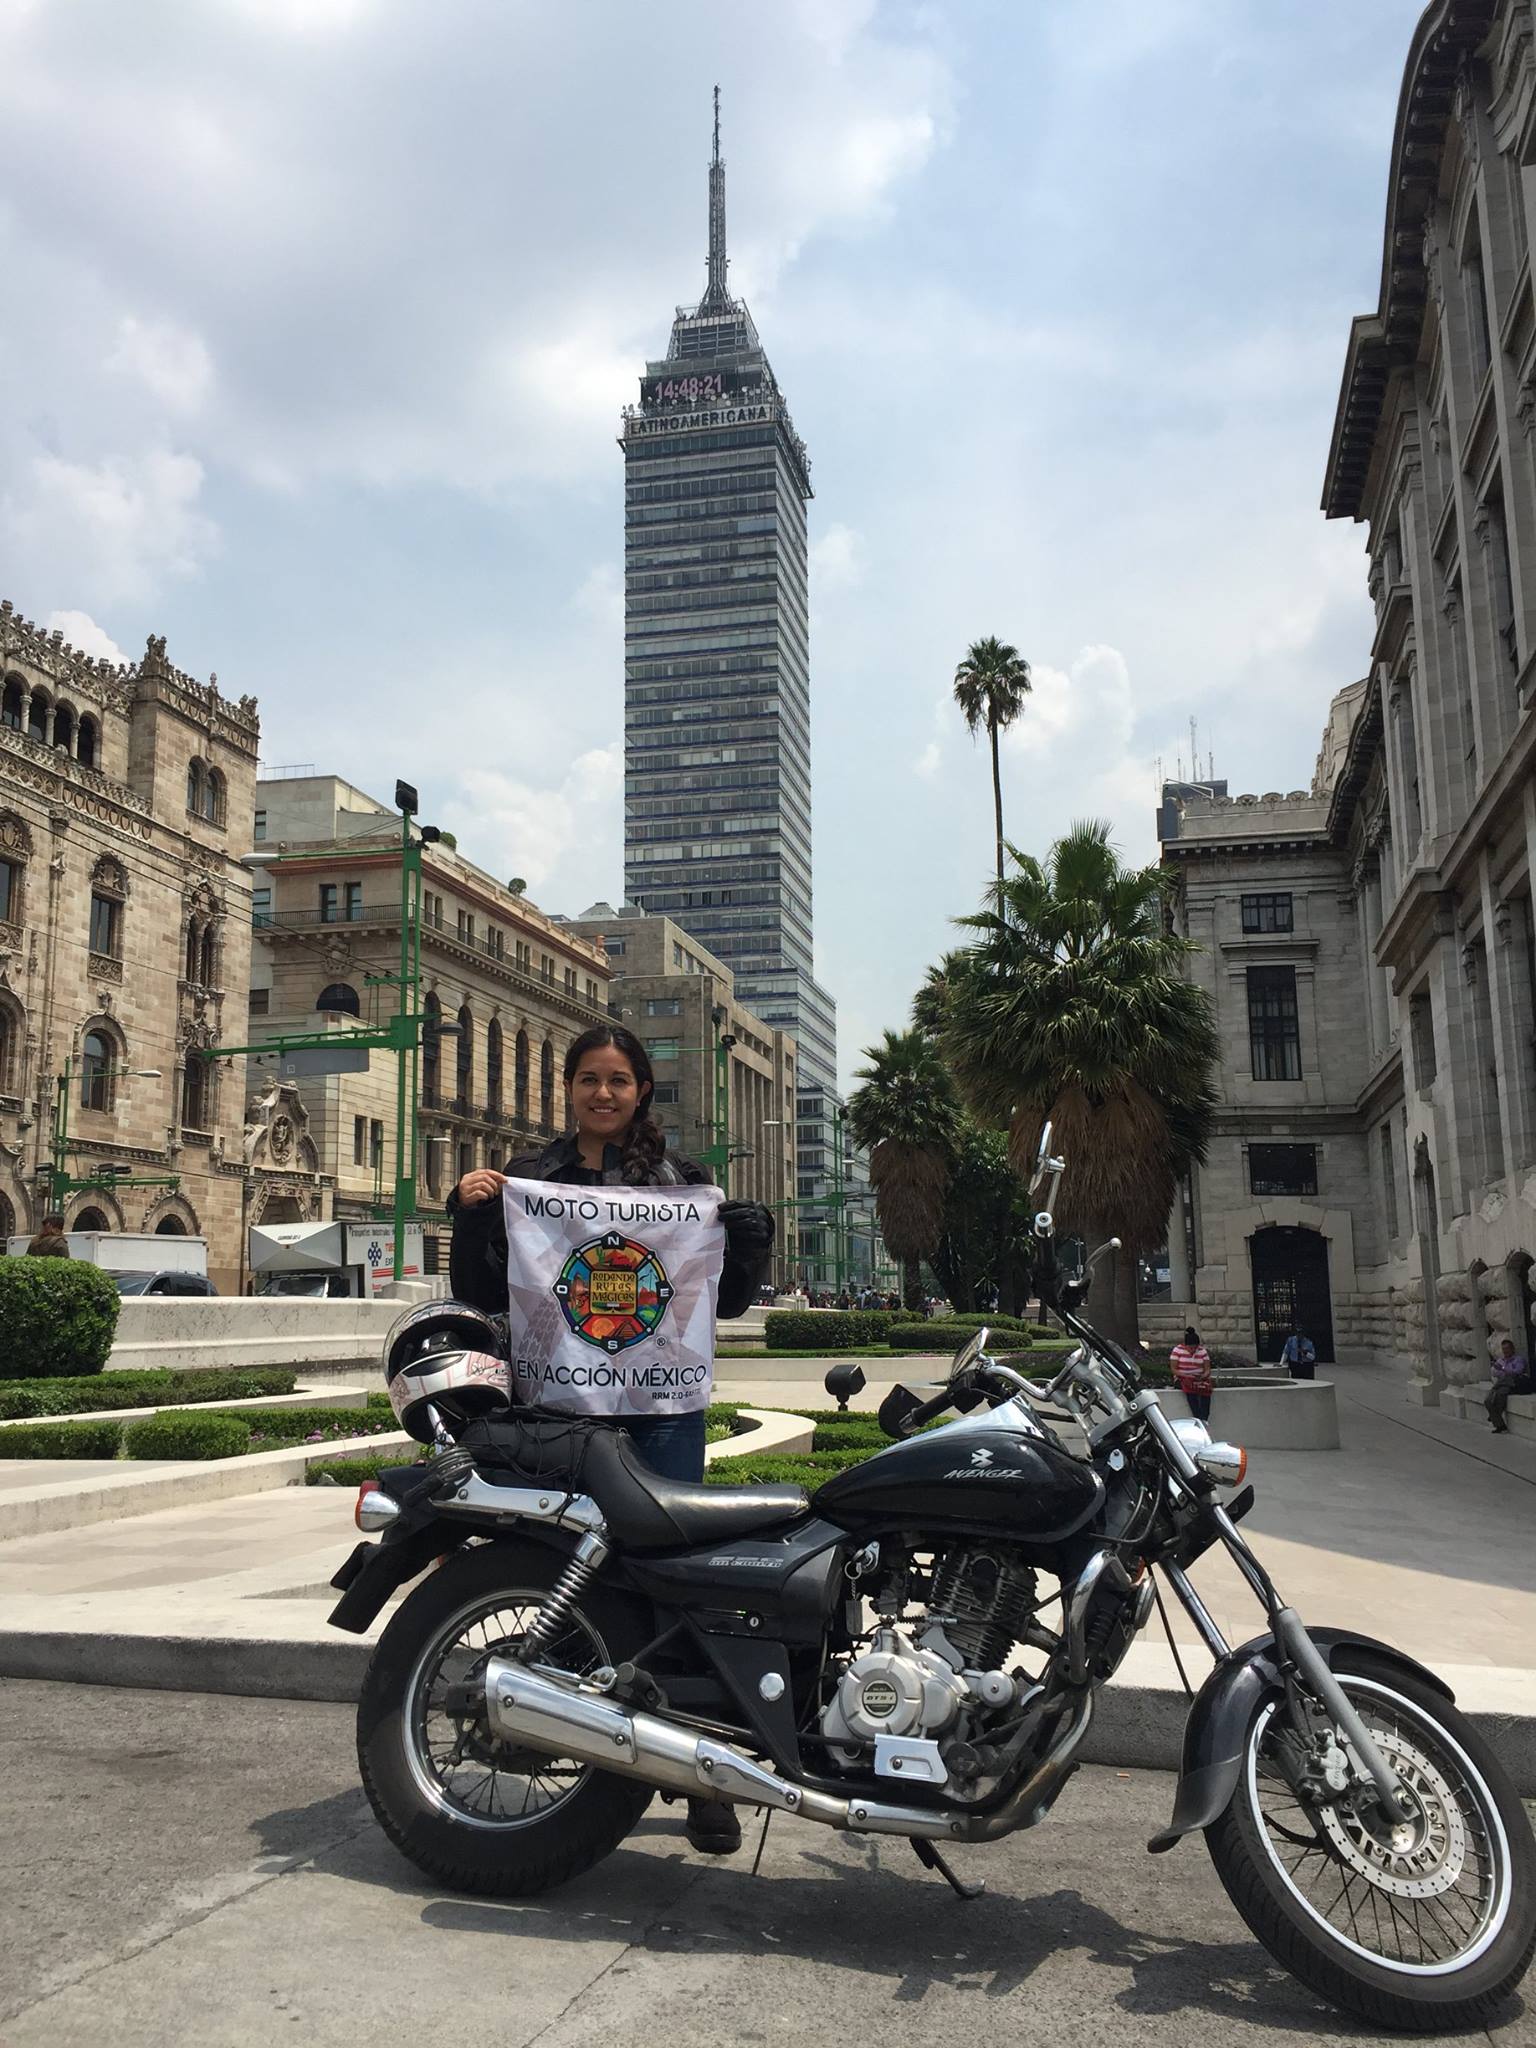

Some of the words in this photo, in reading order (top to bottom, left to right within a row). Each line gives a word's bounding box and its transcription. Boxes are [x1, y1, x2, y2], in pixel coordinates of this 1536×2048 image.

[656, 374, 722, 399] 14:48:21
[631, 406, 767, 434] LATINOAMERICANA
[525, 1195, 598, 1220] MOTO
[605, 1202, 700, 1222] TURISTA
[608, 1237, 619, 1245] N
[660, 1288, 669, 1297] E
[607, 1341, 617, 1349] S
[517, 1360, 538, 1379] EN
[543, 1362, 626, 1386] ACCIÓN
[632, 1362, 706, 1386] MÉXICO
[943, 1469, 1024, 1479] AVENGER
